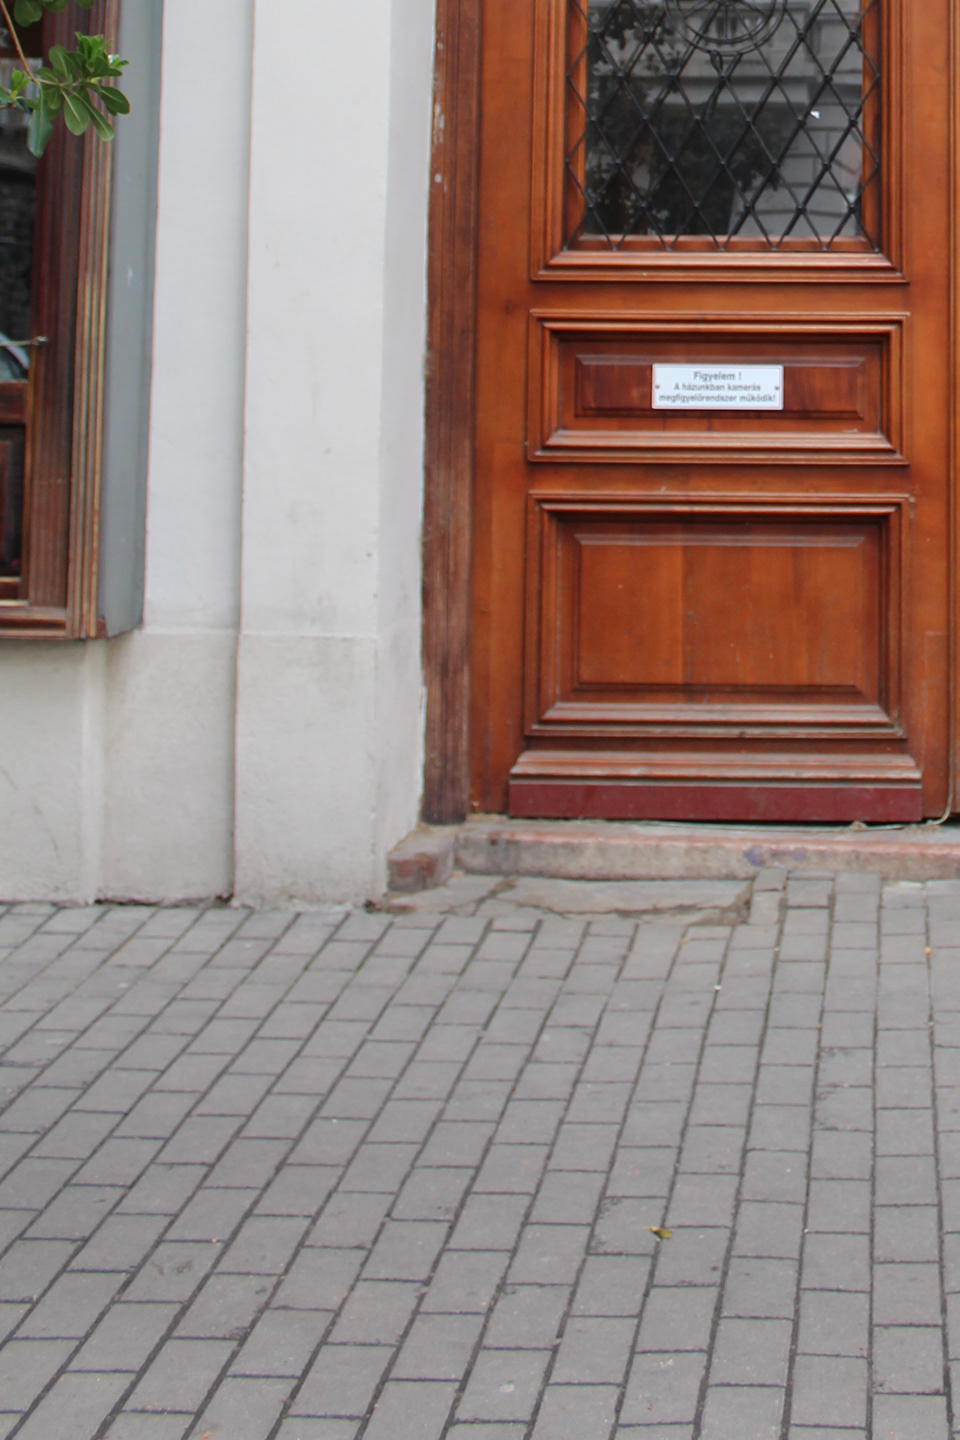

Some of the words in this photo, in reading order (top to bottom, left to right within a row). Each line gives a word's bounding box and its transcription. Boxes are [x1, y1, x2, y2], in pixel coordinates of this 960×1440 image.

[693, 371, 735, 381] Figyelem
[673, 383, 680, 391] A
[681, 383, 725, 391] házunkban
[727, 383, 761, 391] kamerás
[658, 394, 737, 403] megfigyelőrendszer
[739, 393, 776, 402] működik!
